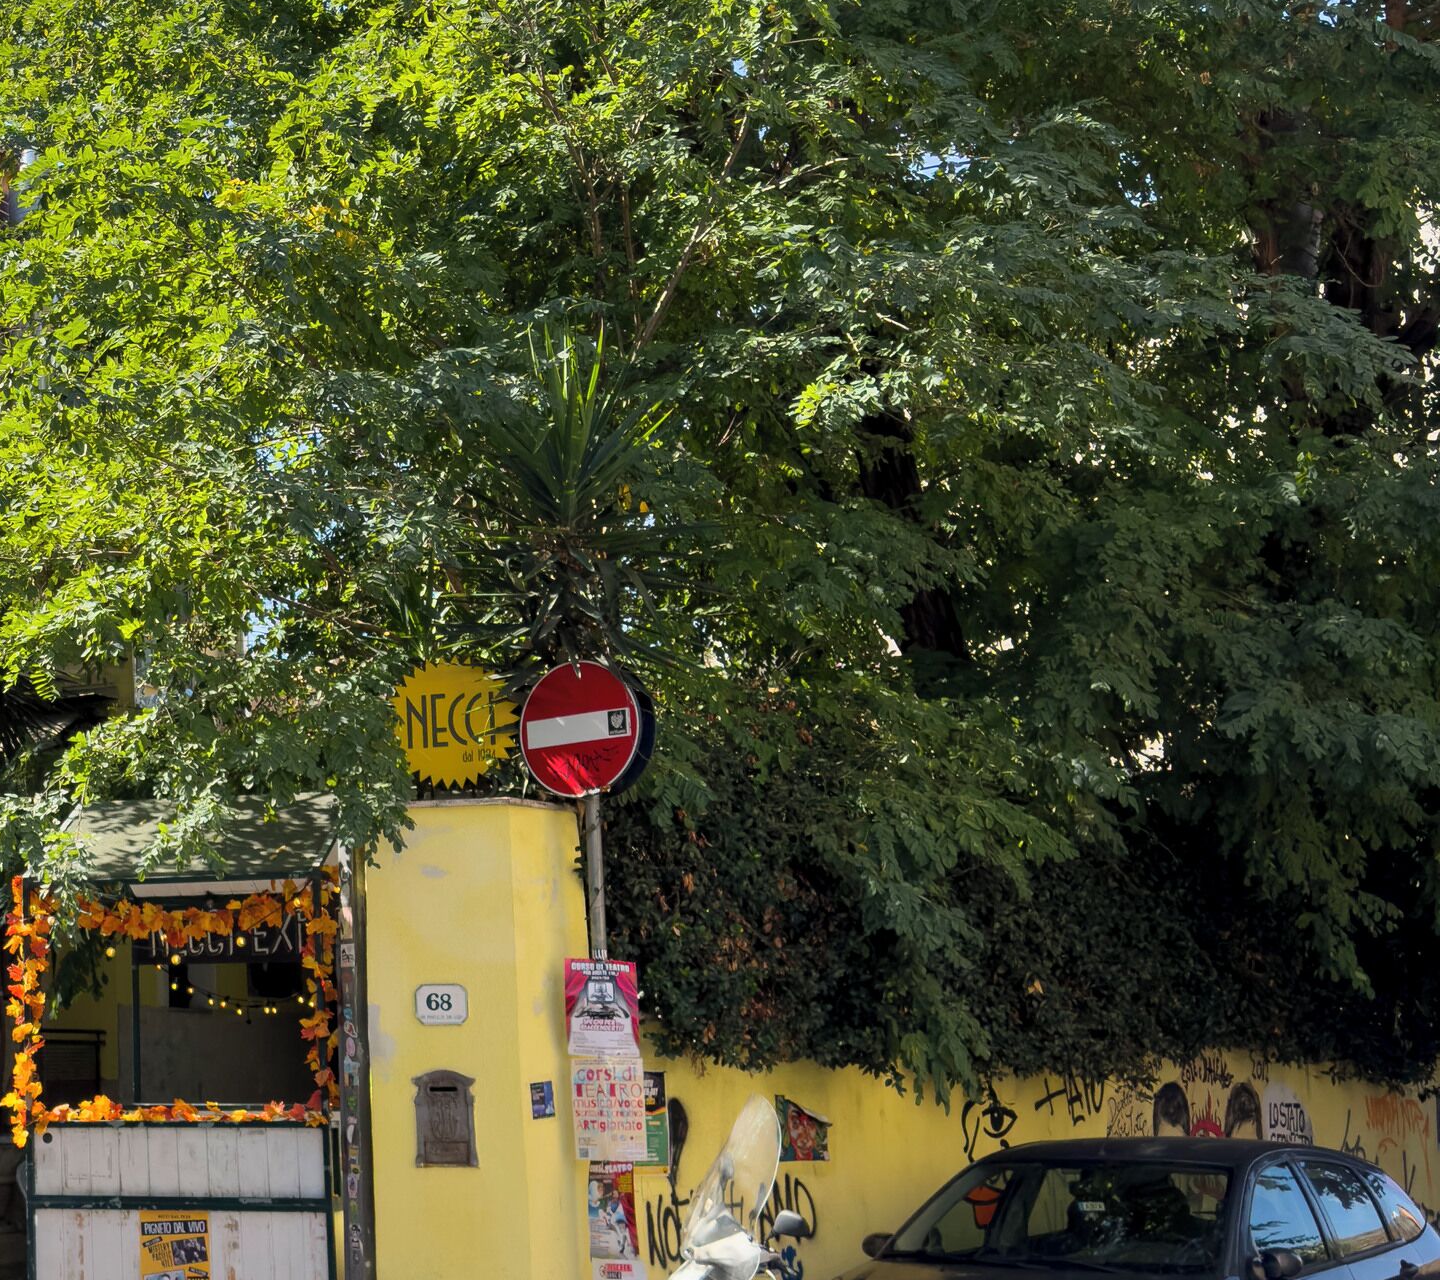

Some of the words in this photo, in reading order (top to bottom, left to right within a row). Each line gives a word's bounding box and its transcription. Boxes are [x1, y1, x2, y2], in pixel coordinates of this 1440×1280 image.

[406, 691, 497, 749] NECCI
[463, 749, 474, 763] dal
[605, 963, 629, 973] TEATRO
[426, 992, 452, 1011] 68
[575, 1083, 642, 1098] TEATRO
[144, 1222, 171, 1234] PIGNETO
[173, 1221, 186, 1233] DAL
[188, 1221, 206, 1233] VIVO
